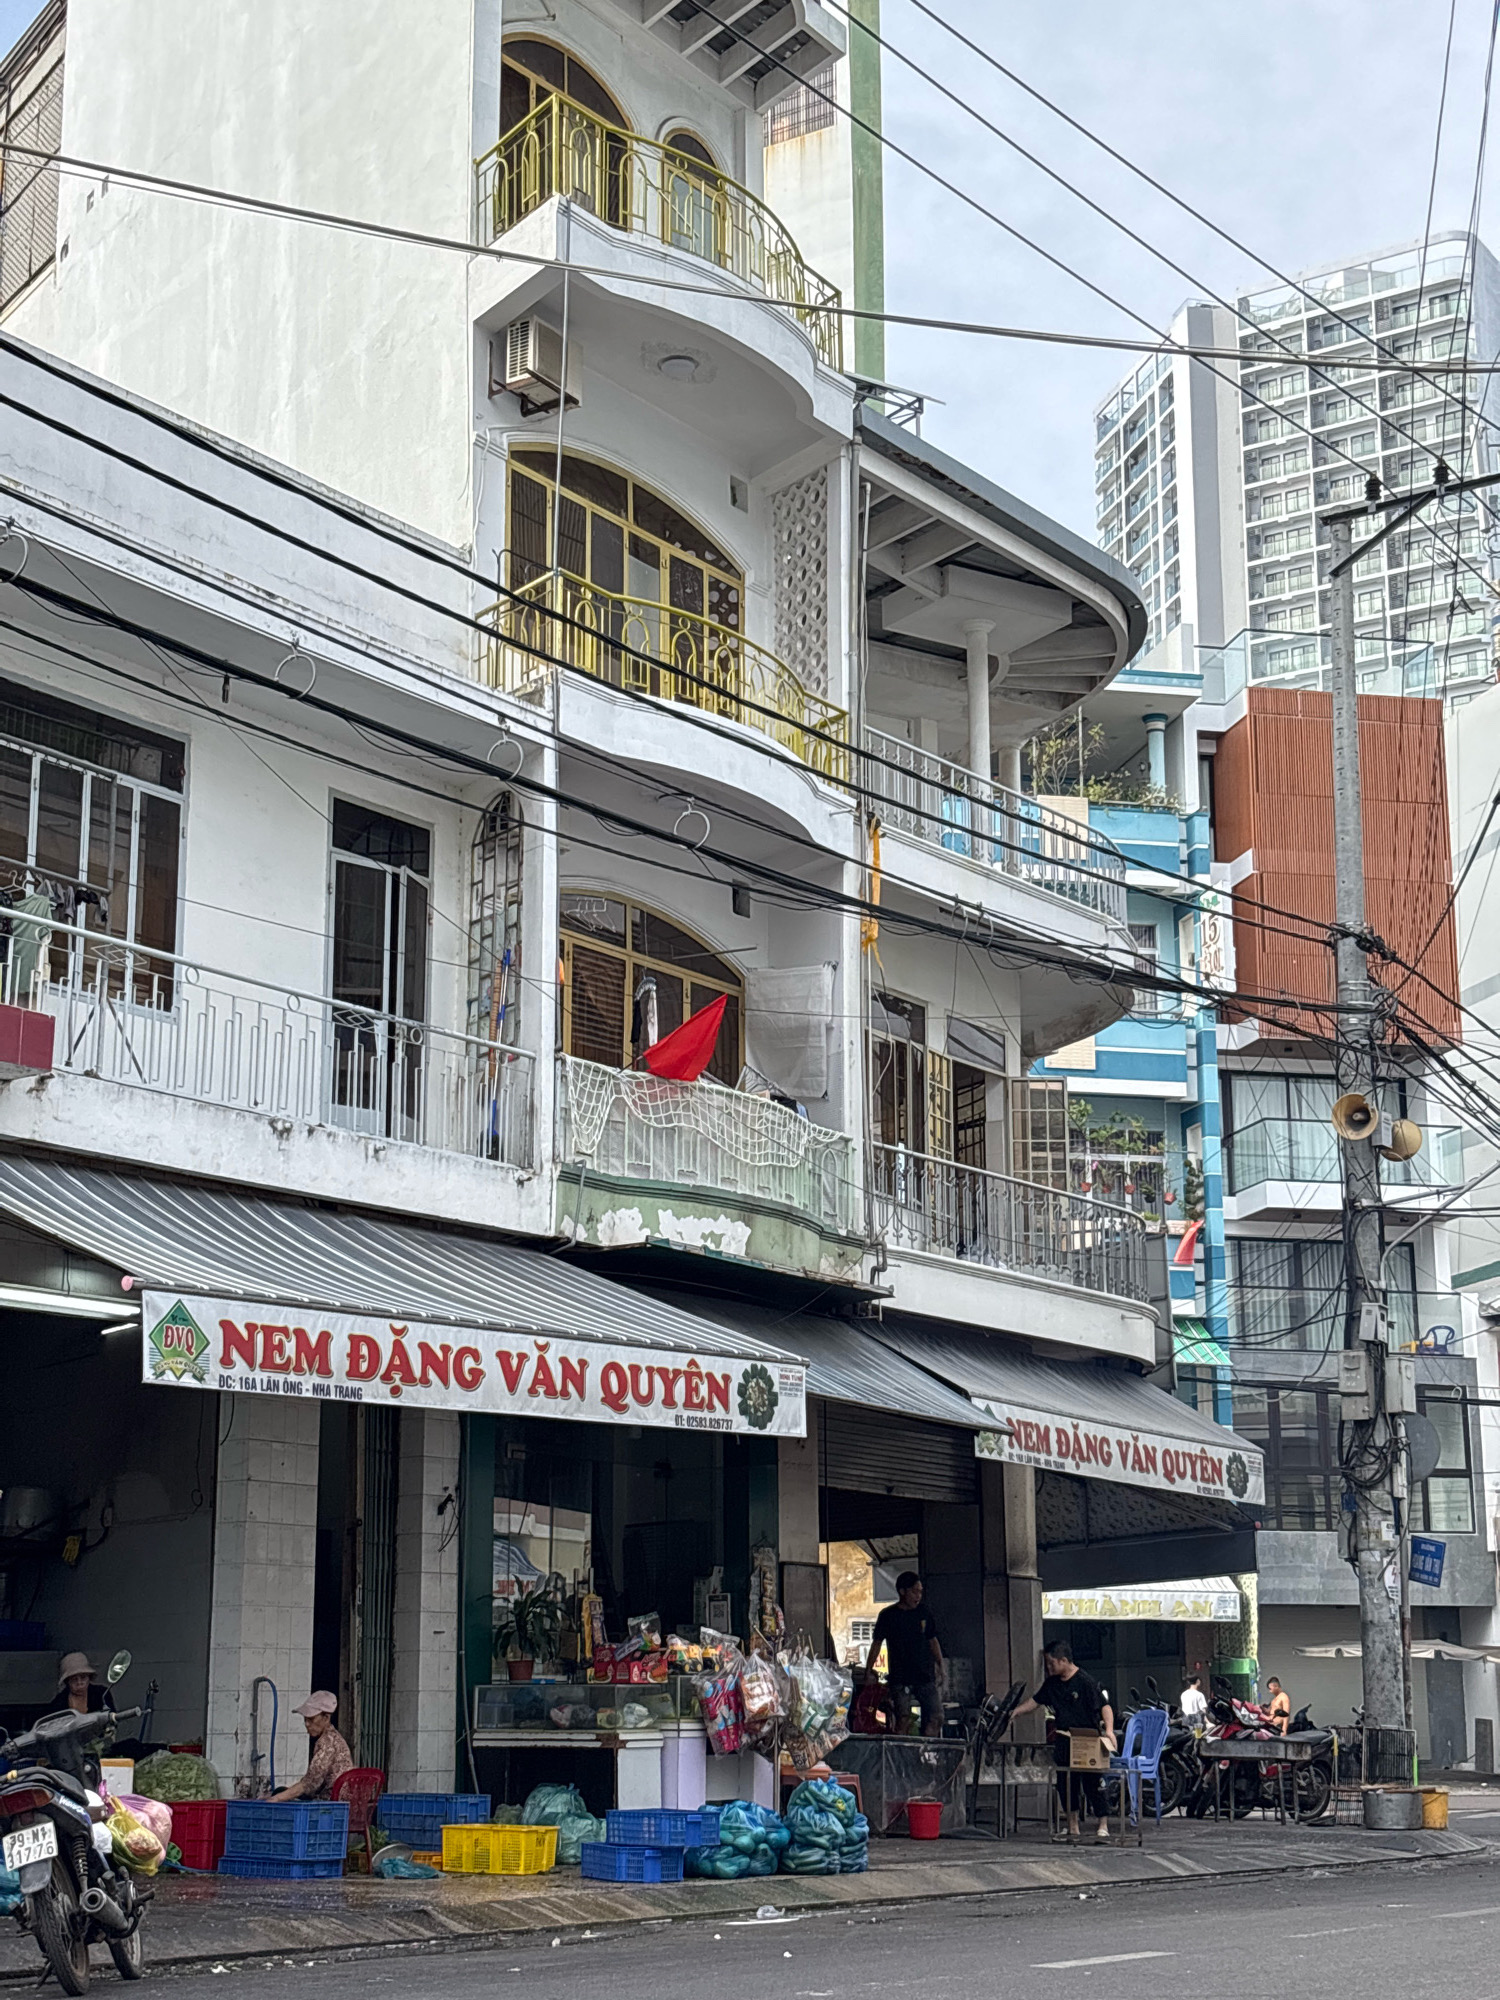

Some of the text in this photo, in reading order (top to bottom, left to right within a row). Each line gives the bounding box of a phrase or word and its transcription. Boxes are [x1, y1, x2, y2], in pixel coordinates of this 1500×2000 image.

[219, 1319, 333, 1378] NEM
[346, 1323, 486, 1398] ĐẶNG
[496, 1339, 589, 1402] VĂN
[600, 1358, 732, 1414] QUYÊN
[219, 1374, 236, 1390] ĐC:
[239, 1376, 258, 1391] 16A
[260, 1375, 280, 1394] LÃN
[282, 1377, 303, 1395] ÔNG
[312, 1382, 331, 1398] NHA
[334, 1384, 363, 1401] TRANG
[1006, 1416, 1053, 1457] NEM
[1055, 1421, 1113, 1471] ĐẶNG
[1116, 1432, 1158, 1475] VĂN
[1162, 1446, 1224, 1488] QUYÊN
[1058, 1594, 1163, 1618] THÀNH
[1171, 1599, 1213, 1618] AN
